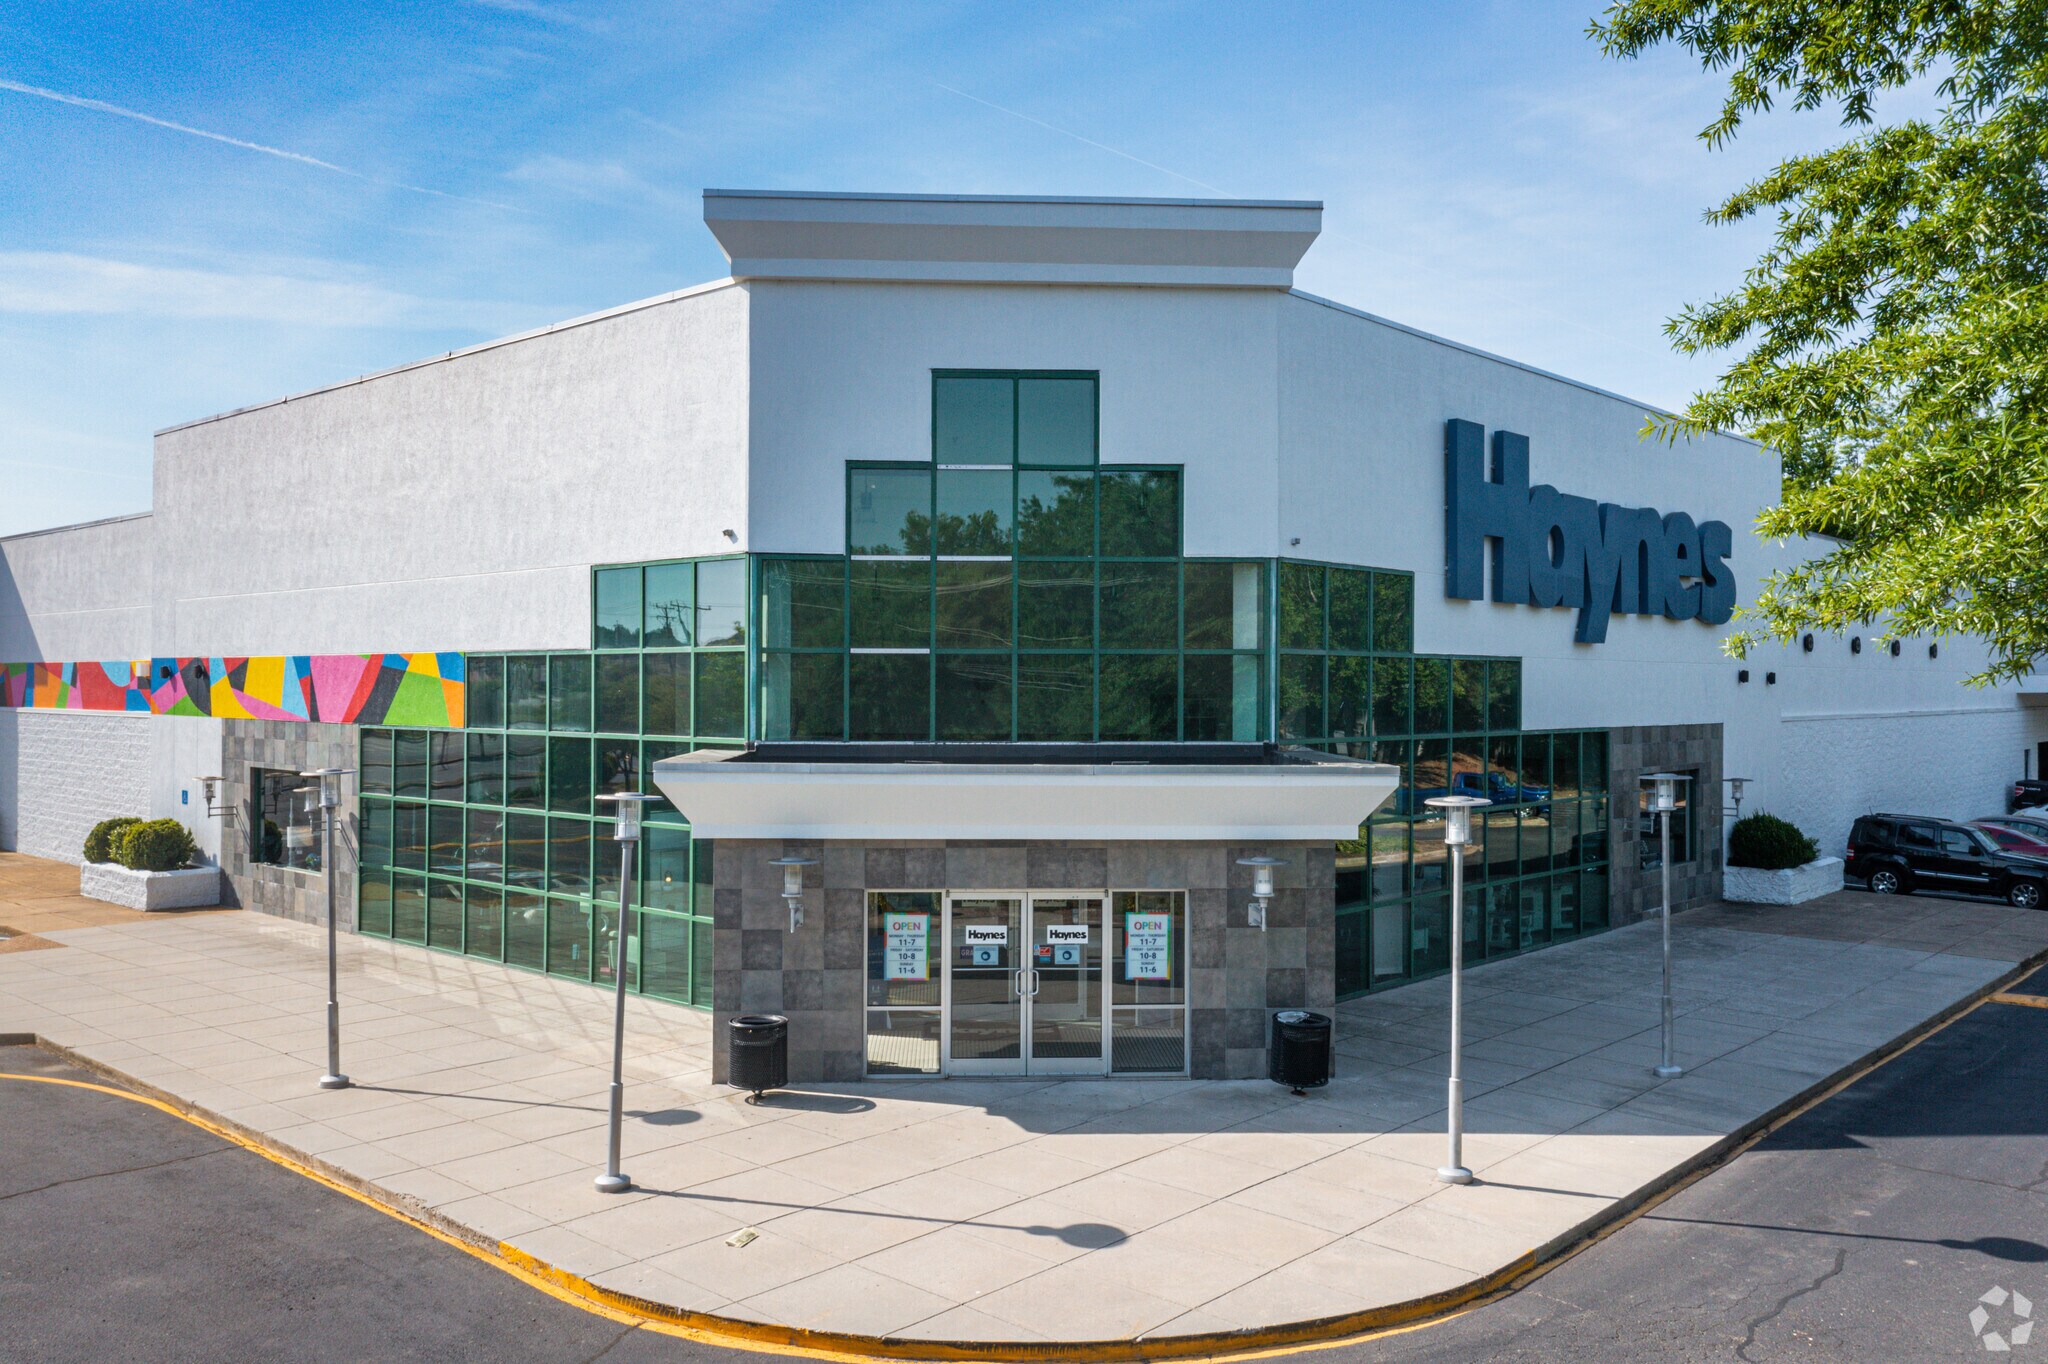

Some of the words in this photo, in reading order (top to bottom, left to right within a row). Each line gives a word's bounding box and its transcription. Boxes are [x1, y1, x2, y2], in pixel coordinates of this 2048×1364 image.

[1447, 418, 1737, 644] Haynes
[893, 921, 921, 931] OPEN
[1134, 921, 1162, 930] OPEN
[968, 930, 1006, 941] Haynes
[1049, 930, 1087, 941] Haynes
